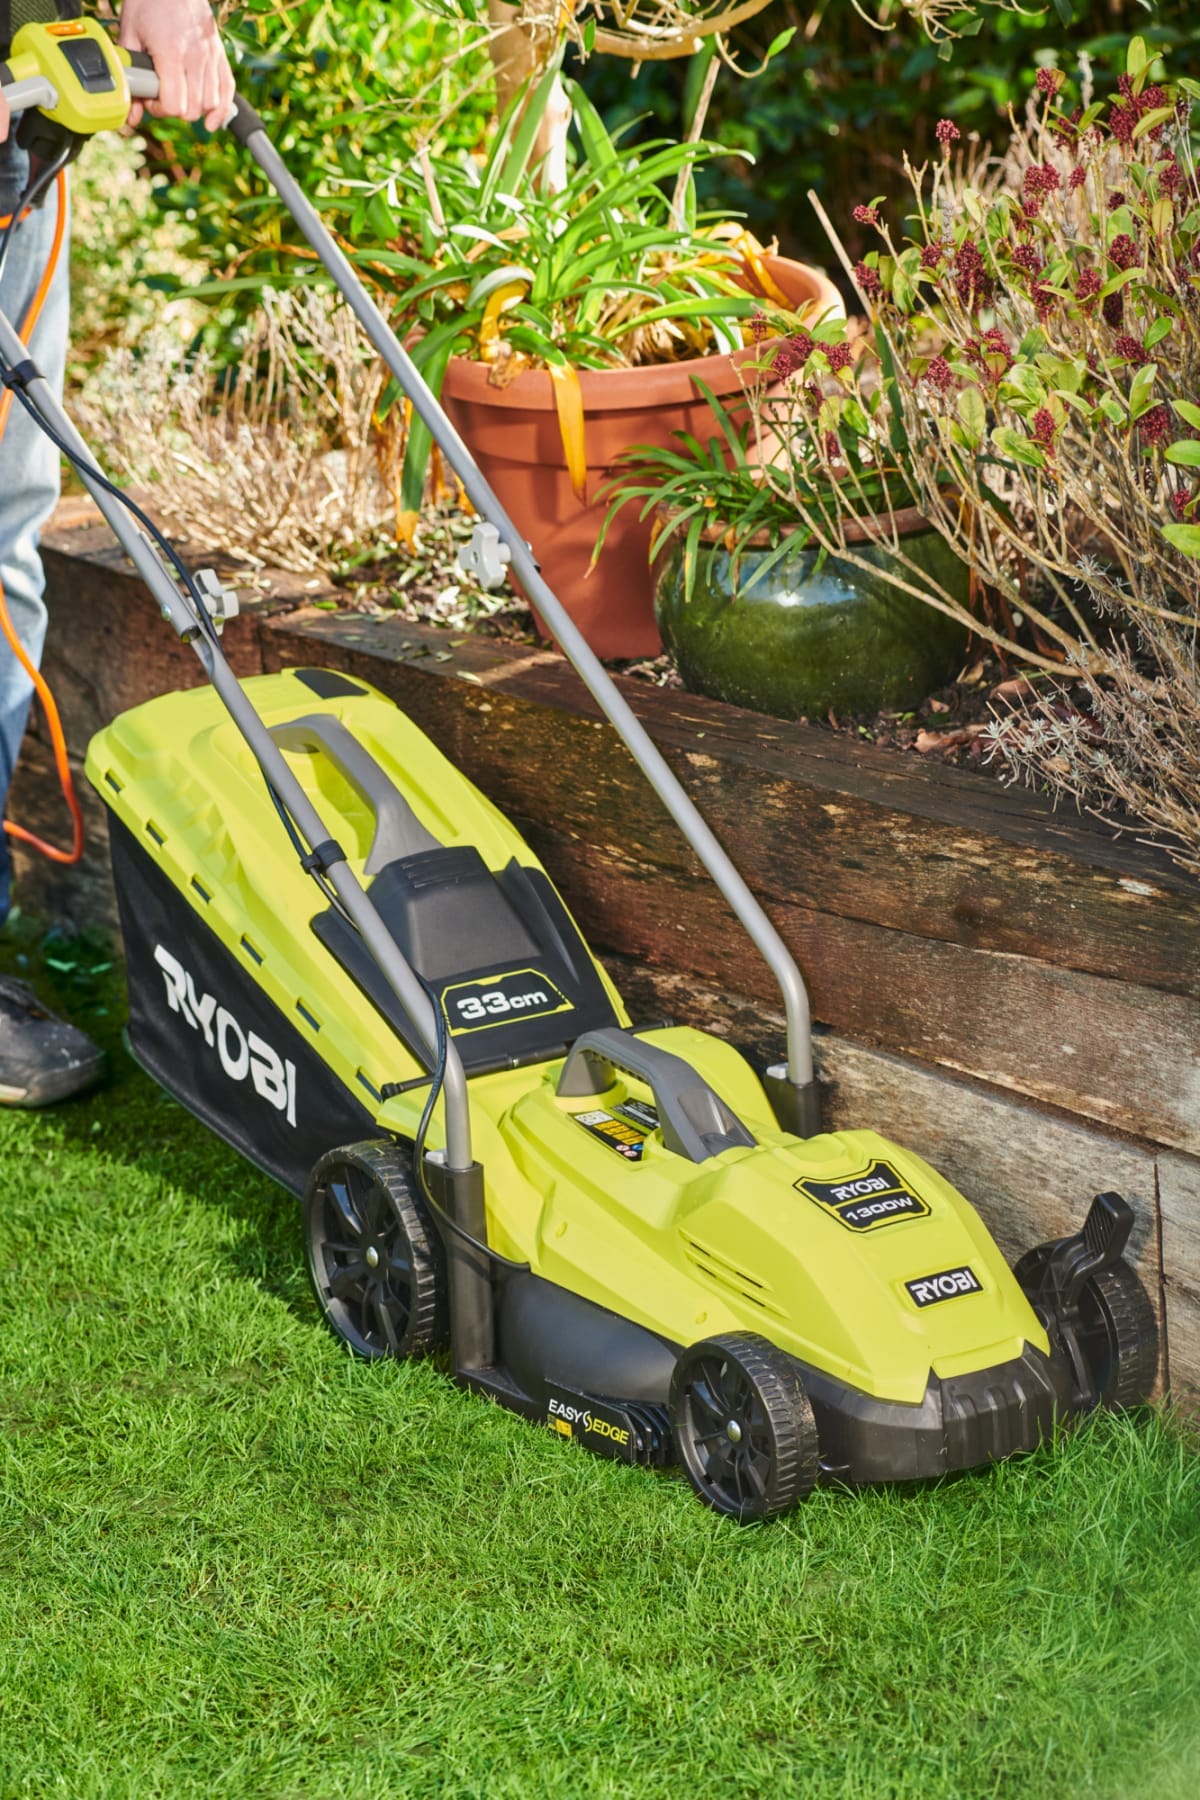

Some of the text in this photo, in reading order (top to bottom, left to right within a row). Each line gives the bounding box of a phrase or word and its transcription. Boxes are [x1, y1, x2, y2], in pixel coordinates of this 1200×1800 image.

[456, 991, 549, 1020] 33cm
[153, 943, 297, 1128] RYOBI
[830, 1177, 890, 1201] RYOBI
[846, 1197, 913, 1221] 1300W
[910, 1269, 978, 1303] RYOBI
[548, 1398, 582, 1423] EASY
[592, 1418, 630, 1445] EDGE
